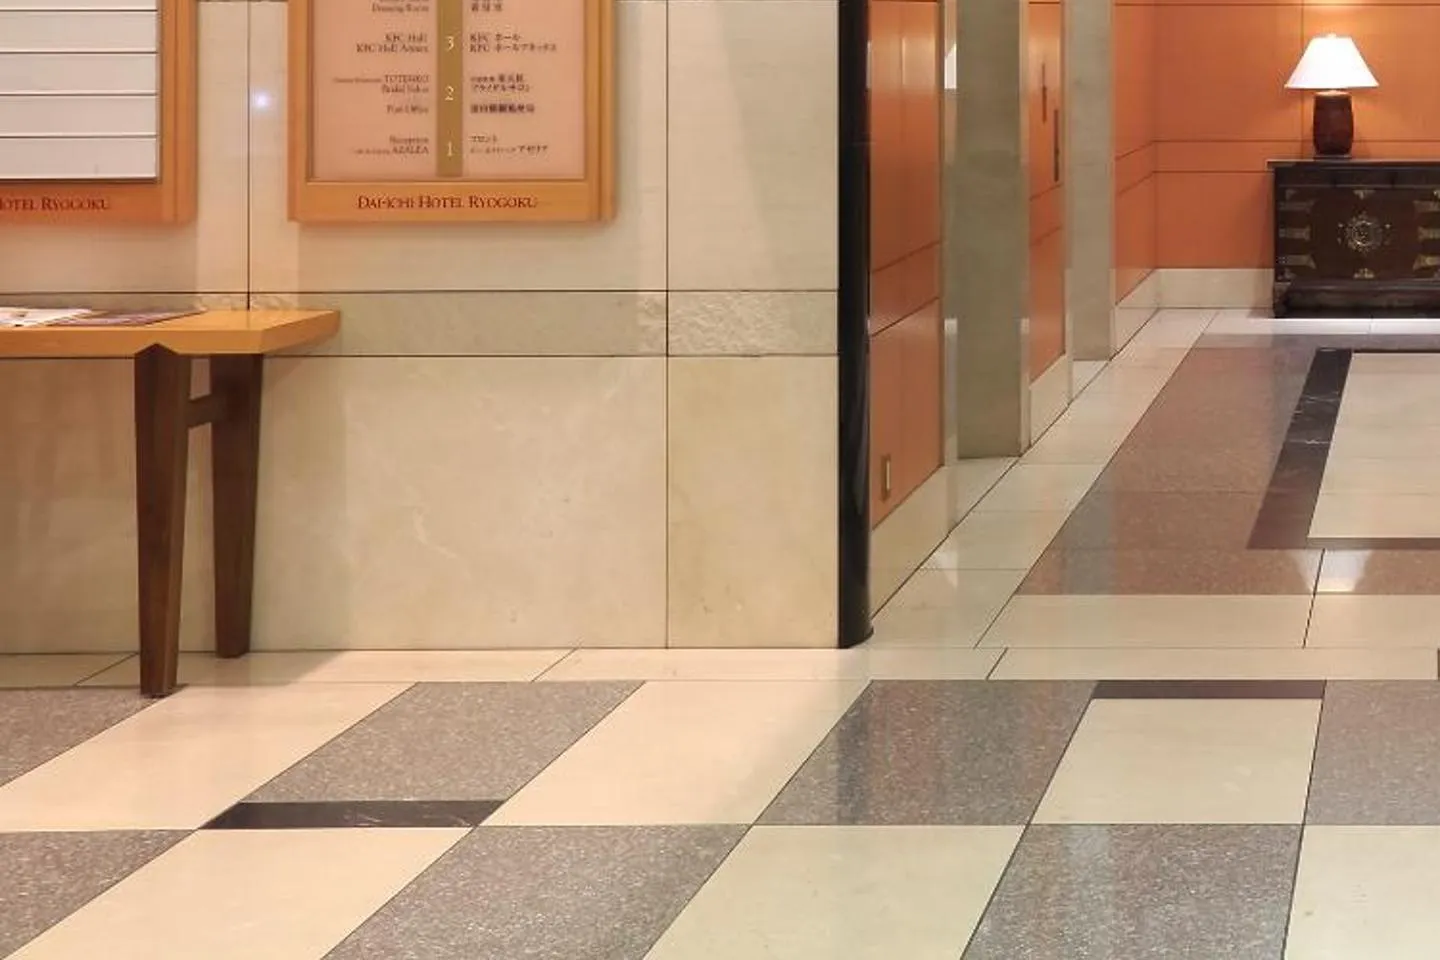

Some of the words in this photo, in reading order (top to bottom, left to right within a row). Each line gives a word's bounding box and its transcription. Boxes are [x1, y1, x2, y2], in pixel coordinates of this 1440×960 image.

[446, 36, 455, 52] 3
[445, 86, 454, 101] 2
[447, 141, 454, 157] 1
